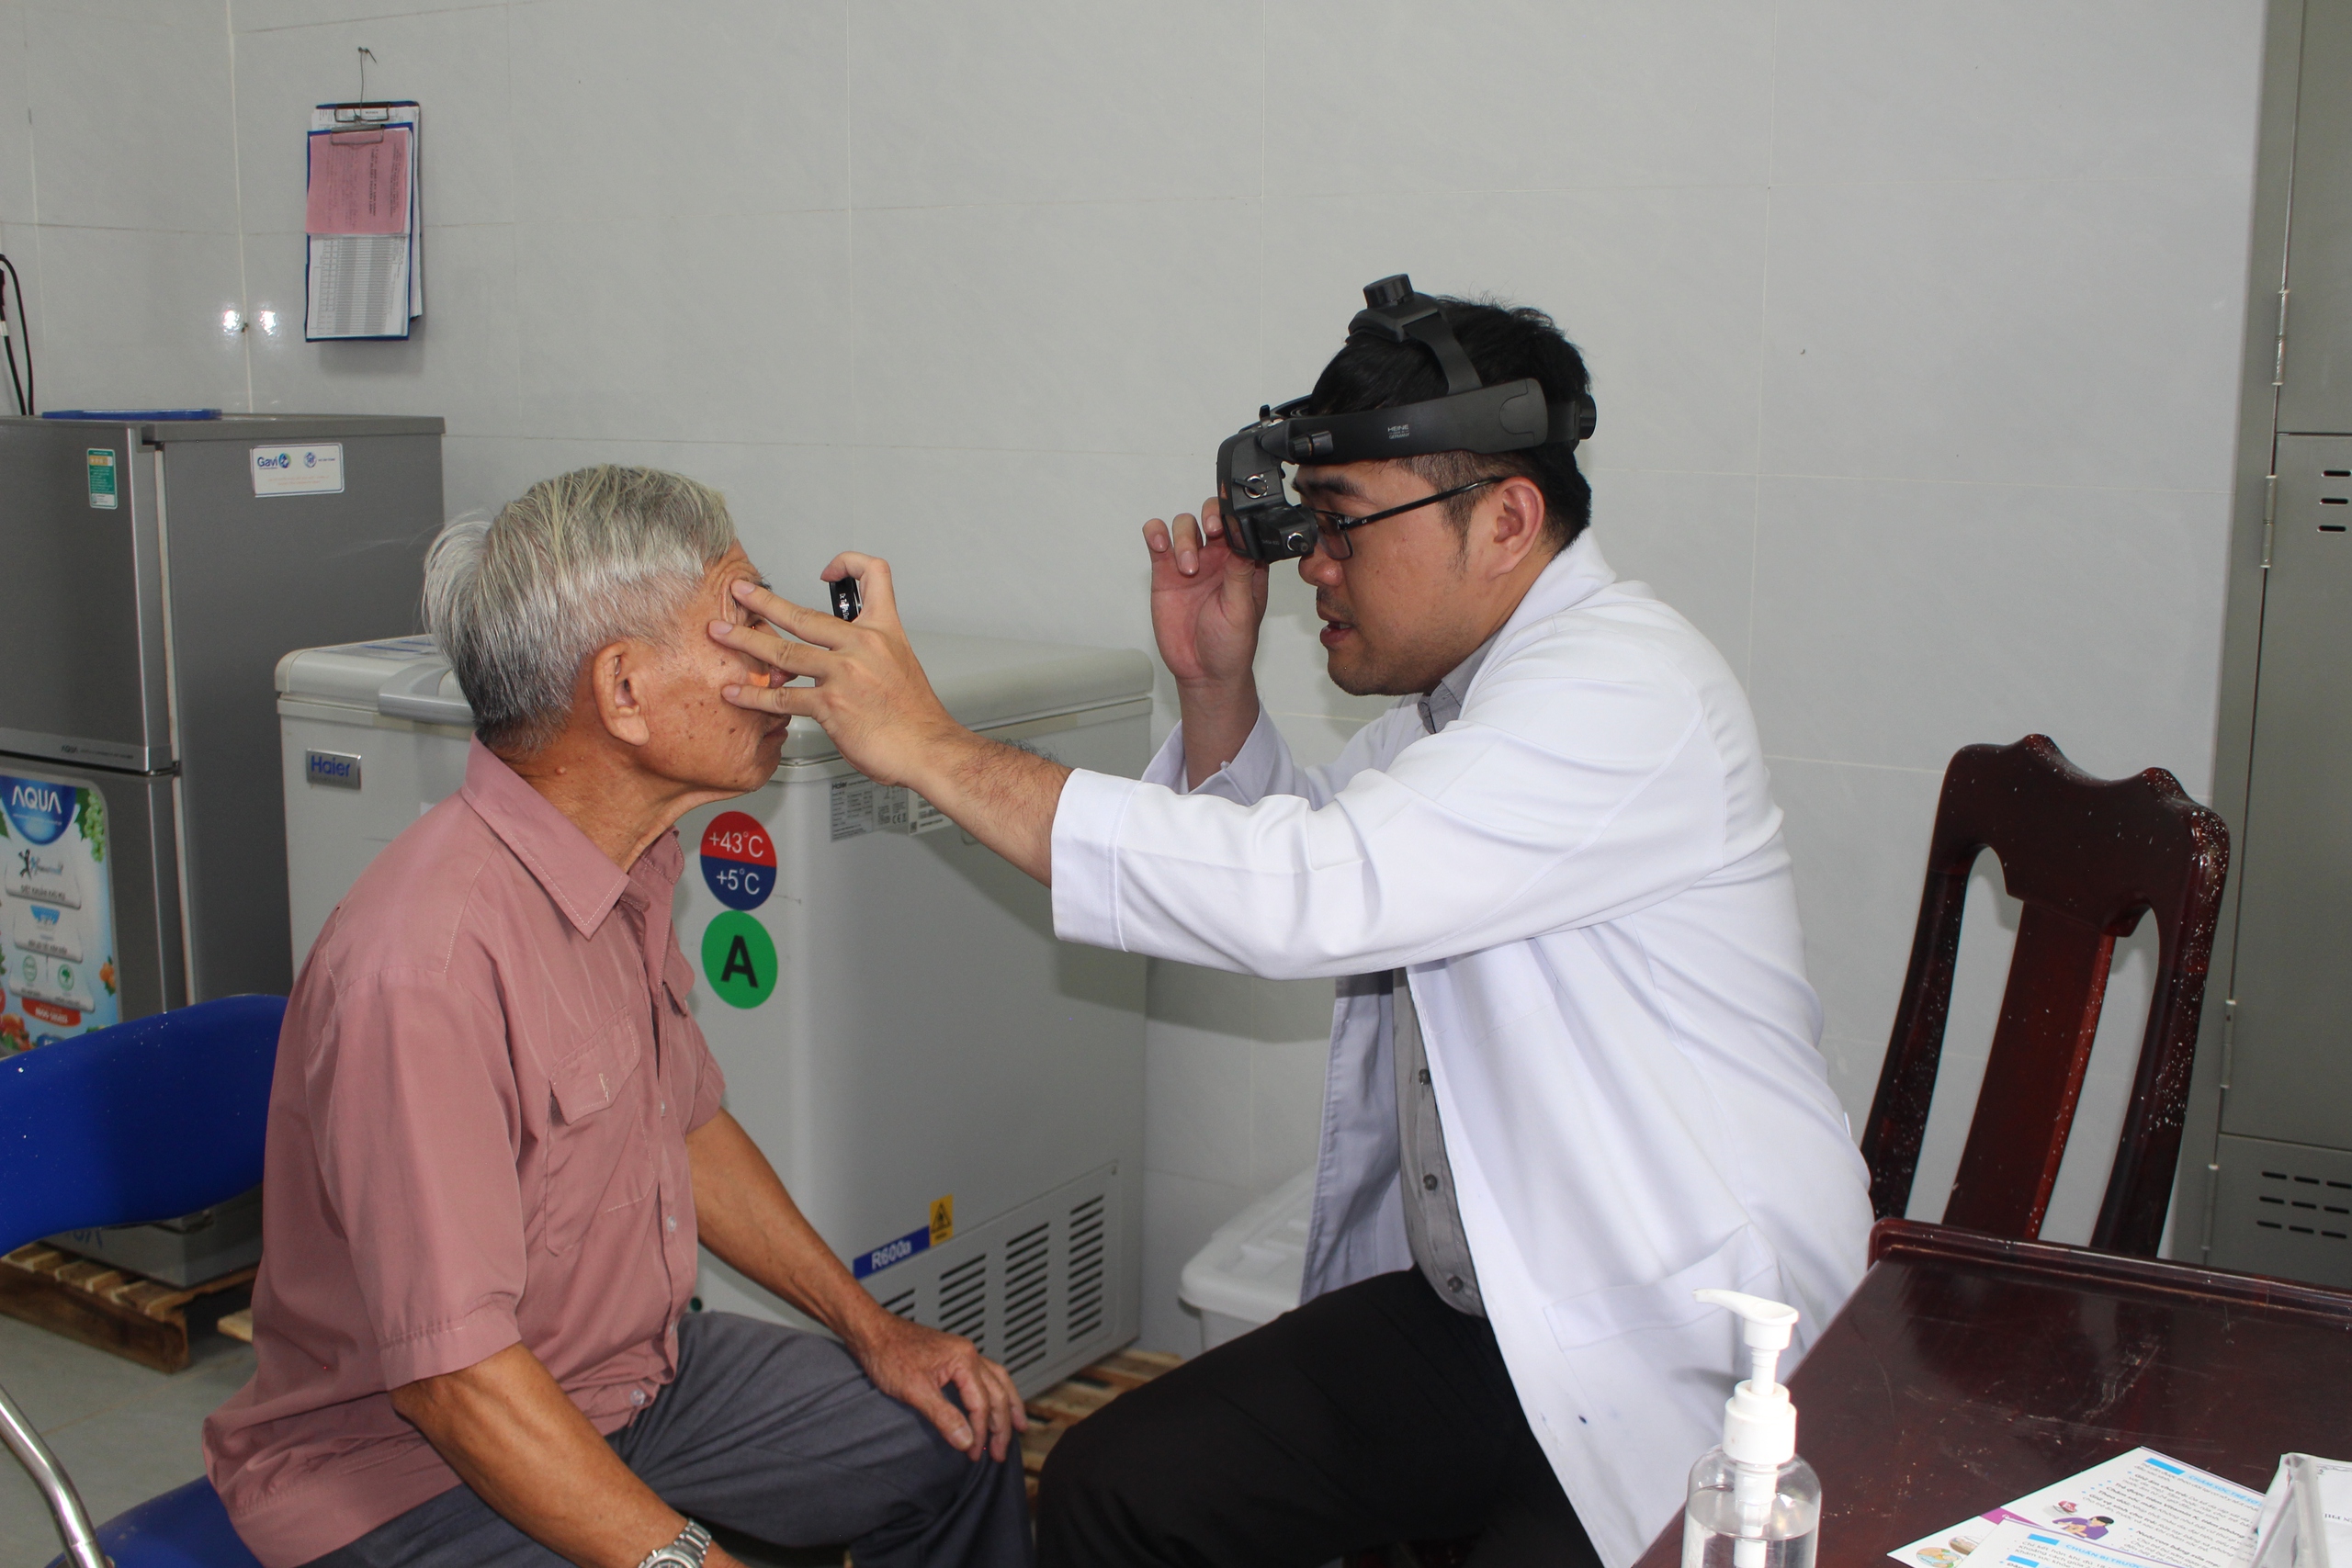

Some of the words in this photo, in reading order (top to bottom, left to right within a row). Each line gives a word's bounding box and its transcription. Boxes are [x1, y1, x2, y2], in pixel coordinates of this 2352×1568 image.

[1387, 423, 1409, 433] HEINE
[257, 456, 278, 468] Gavi
[311, 755, 351, 777] Haier
[11, 784, 62, 815] AQUA
[720, 934, 759, 988] A
[871, 1240, 912, 1270] R600a
